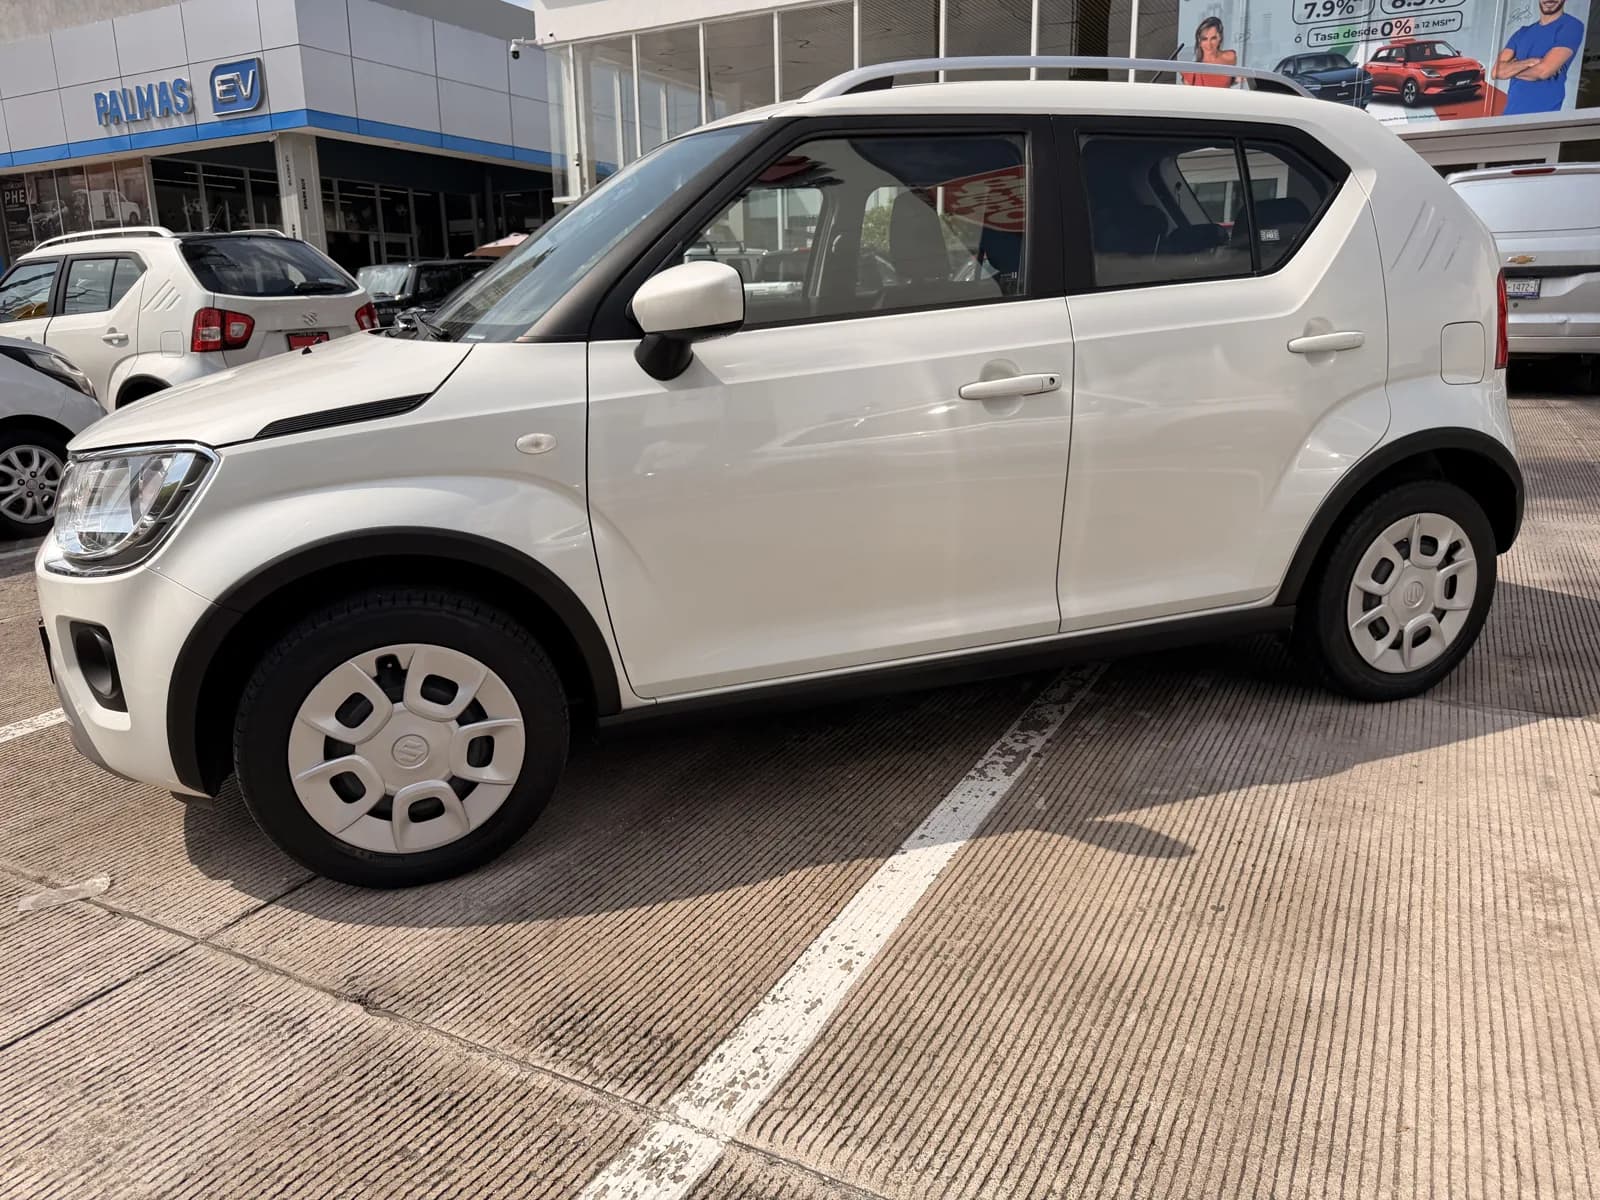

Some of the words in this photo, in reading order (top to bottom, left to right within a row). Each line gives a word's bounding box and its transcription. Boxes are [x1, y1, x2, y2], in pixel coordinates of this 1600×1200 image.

[1313, 31, 1340, 42] Tasa
[1342, 26, 1378, 39] desde
[1380, 19, 1412, 37] 0%
[94, 78, 191, 125] PALMAS
[214, 69, 255, 101] EV
